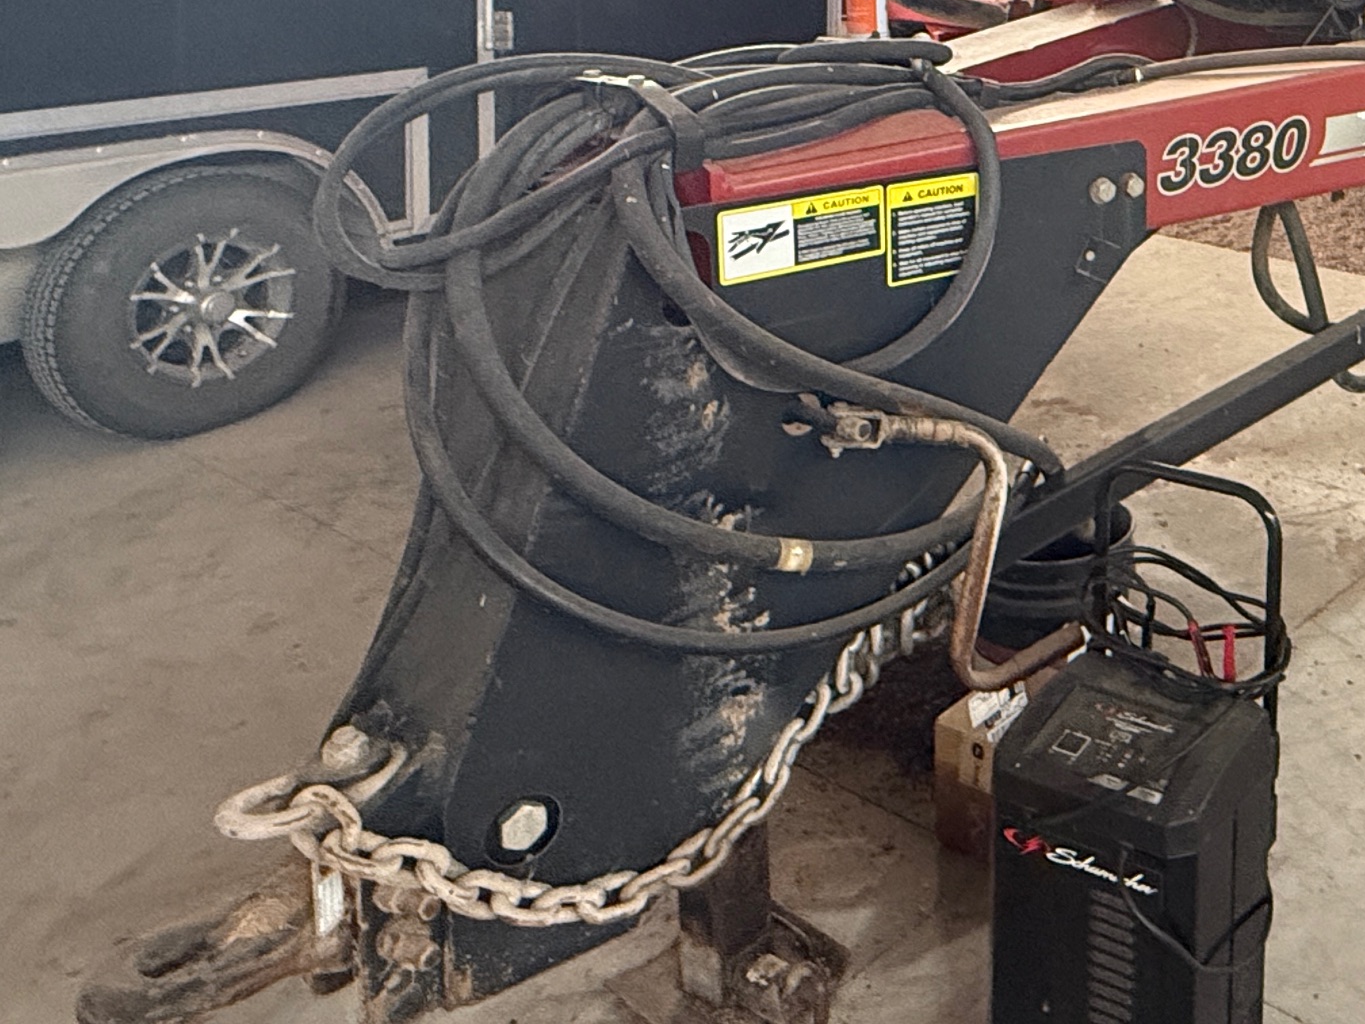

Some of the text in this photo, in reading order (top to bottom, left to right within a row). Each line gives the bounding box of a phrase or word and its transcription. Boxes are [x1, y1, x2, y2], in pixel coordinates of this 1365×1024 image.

[1157, 114, 1311, 197] 3380
[917, 184, 964, 200] CAUTION
[822, 195, 870, 211] CAUTION
